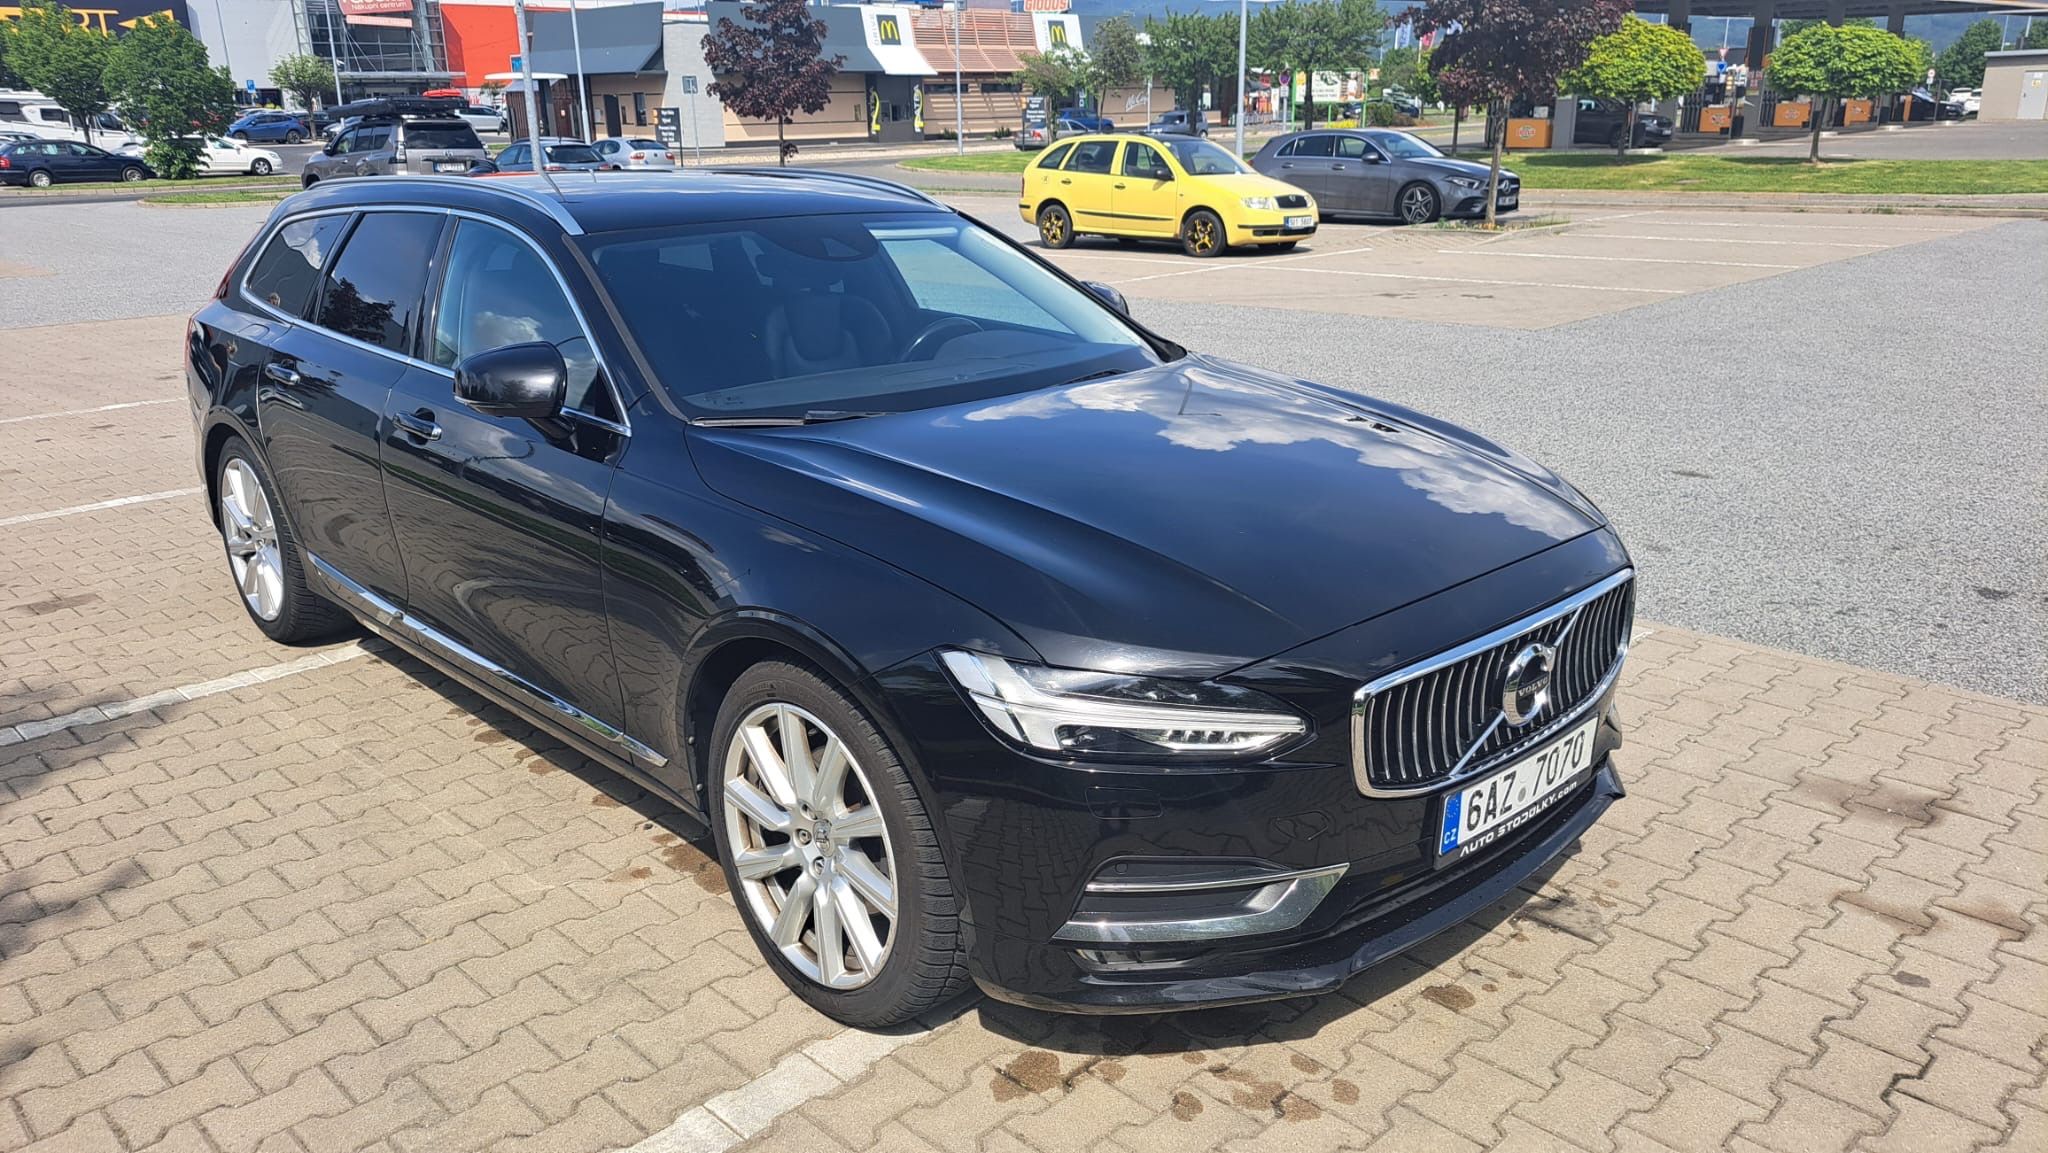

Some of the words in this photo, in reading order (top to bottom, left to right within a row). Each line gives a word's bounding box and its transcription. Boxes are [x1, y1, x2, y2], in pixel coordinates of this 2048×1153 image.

[380, 1, 407, 9] centrum
[1518, 676, 1548, 697] VOLVO
[1466, 770, 1517, 832] 6AZ
[1532, 729, 1586, 797] 7070
[1443, 827, 1457, 845] CZ
[1459, 831, 1494, 858] AUTO
